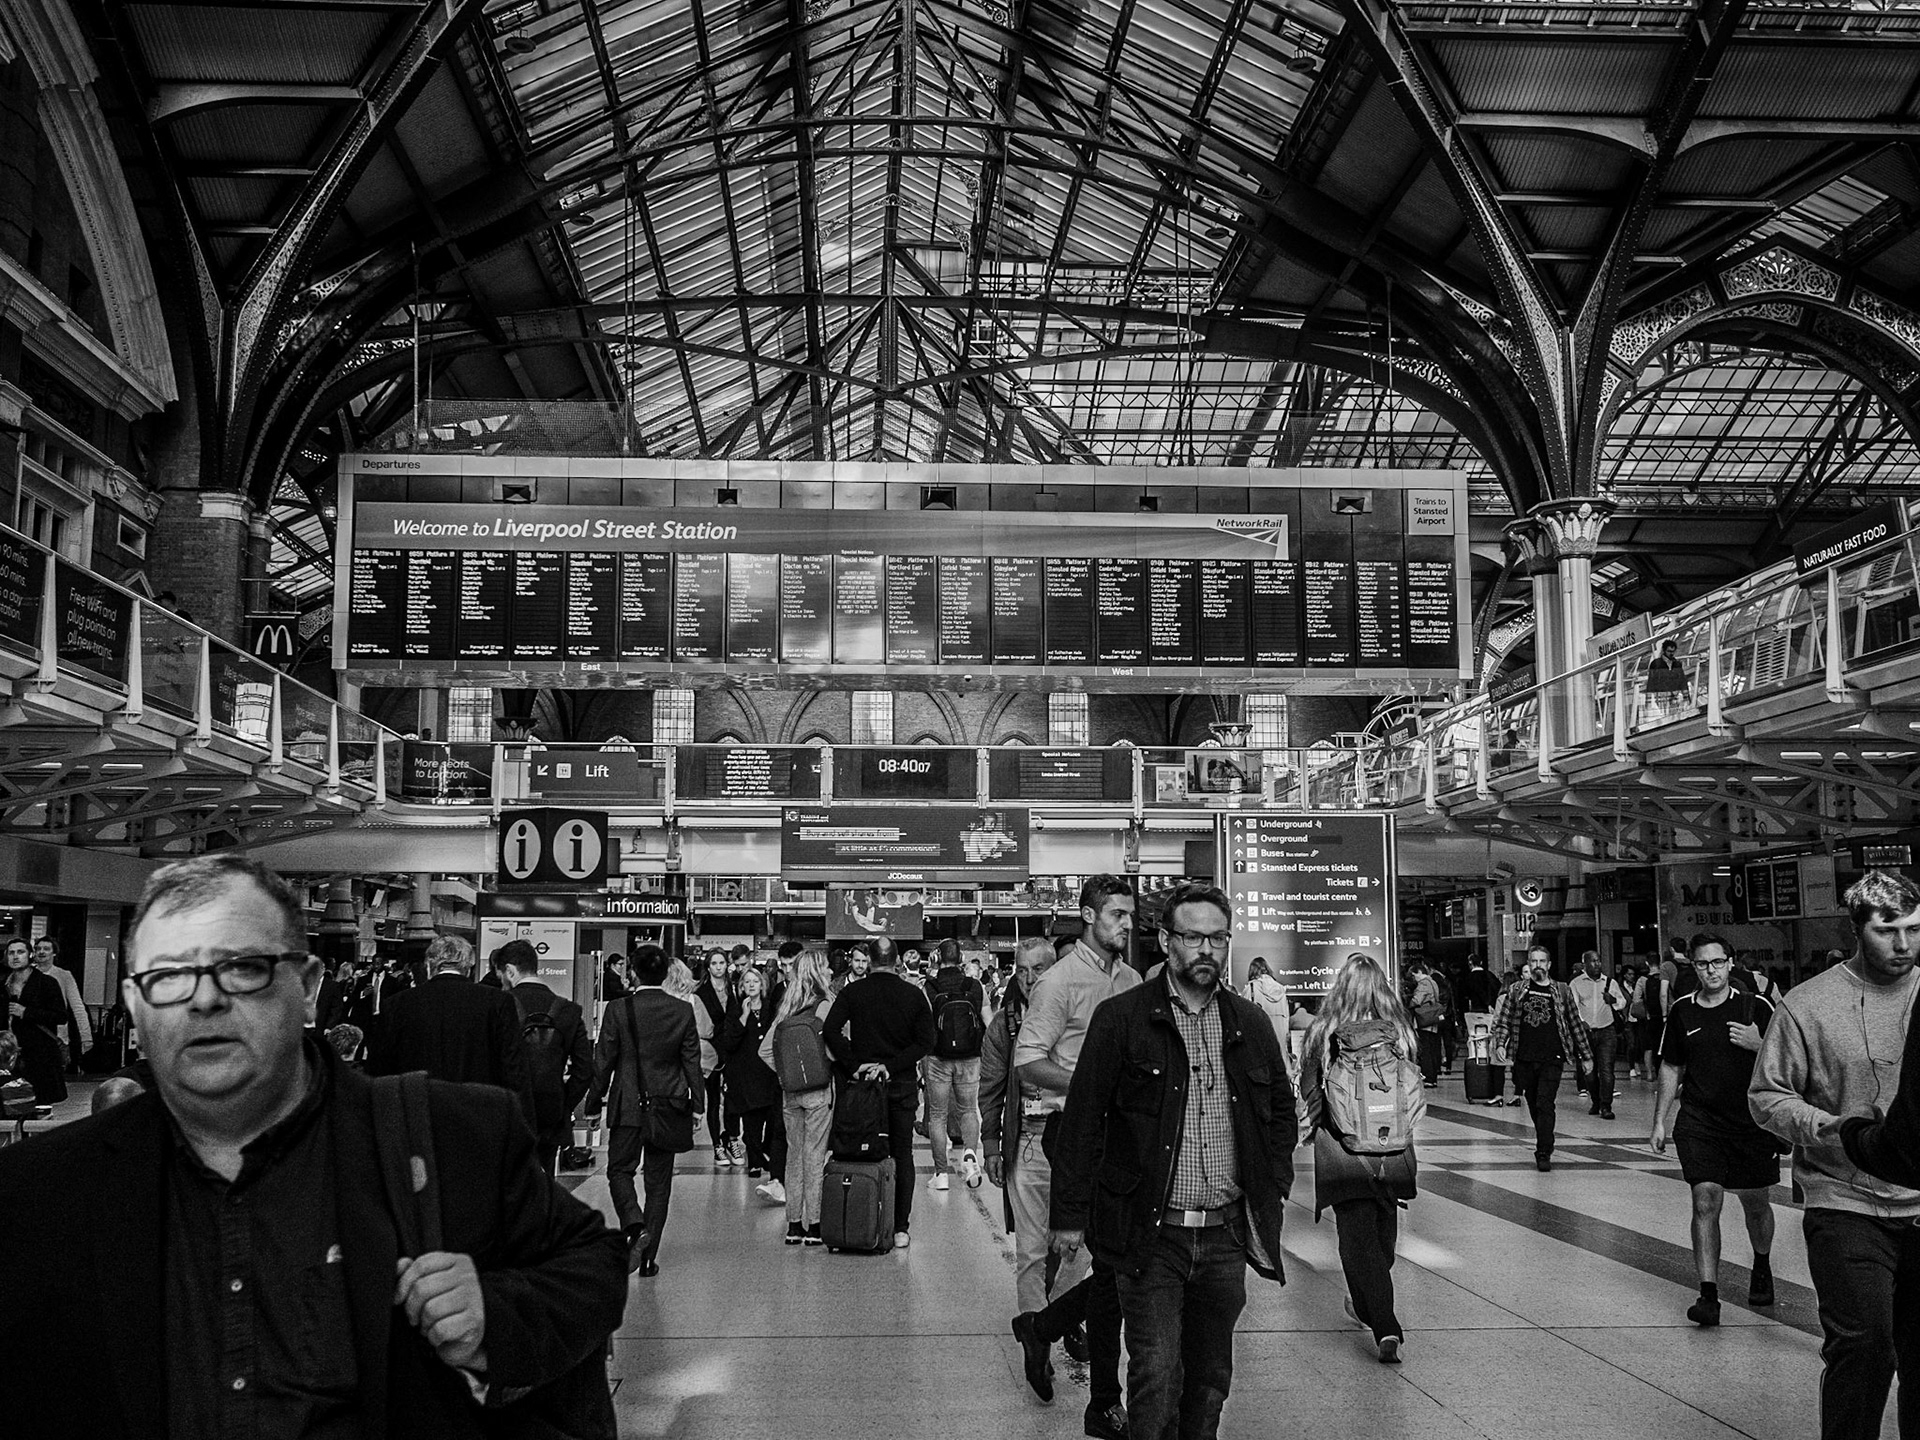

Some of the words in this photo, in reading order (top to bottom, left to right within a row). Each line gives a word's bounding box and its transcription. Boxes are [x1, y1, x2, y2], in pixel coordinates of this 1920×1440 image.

[362, 459, 421, 470] Departures
[1414, 497, 1436, 506] Trains
[1437, 498, 1446, 506] to
[1413, 507, 1448, 516] Stansted
[1416, 516, 1446, 526] Airport
[393, 519, 468, 537] Welcome
[472, 522, 490, 537] to
[493, 518, 588, 542] Liverpool
[592, 520, 656, 540] Street
[661, 520, 738, 540] Station
[1803, 542, 1843, 568] NATURALLY
[1844, 534, 1862, 551] FAST
[1862, 523, 1887, 543] FOOD
[70, 586, 86, 608] Free
[102, 607, 117, 622] and
[67, 608, 85, 630] plug
[85, 618, 106, 638] points
[106, 628, 116, 640] on
[581, 663, 600, 671] East
[1112, 668, 1134, 676] West
[414, 758, 439, 768] More
[441, 760, 470, 769] seats
[415, 770, 426, 779] to
[585, 764, 609, 778] Lift
[1260, 820, 1313, 830] Underground
[1260, 834, 1308, 844] Overground
[1261, 849, 1284, 858] Buses
[1261, 864, 1297, 872] Stansted
[1298, 864, 1330, 873] Express
[1331, 864, 1358, 872] tickets
[888, 872, 923, 880] JCDecaux
[1326, 878, 1354, 887] Tickets
[1734, 874, 1743, 898] 8
[1261, 893, 1285, 901] Travel
[1286, 893, 1301, 901] and
[1302, 893, 1330, 901] tourist
[606, 898, 680, 915] information
[1262, 907, 1276, 916] Lift
[1262, 922, 1280, 932] Way
[1335, 937, 1356, 945] Taxis
[545, 967, 567, 976] Street
[1311, 966, 1333, 976] Cycle
